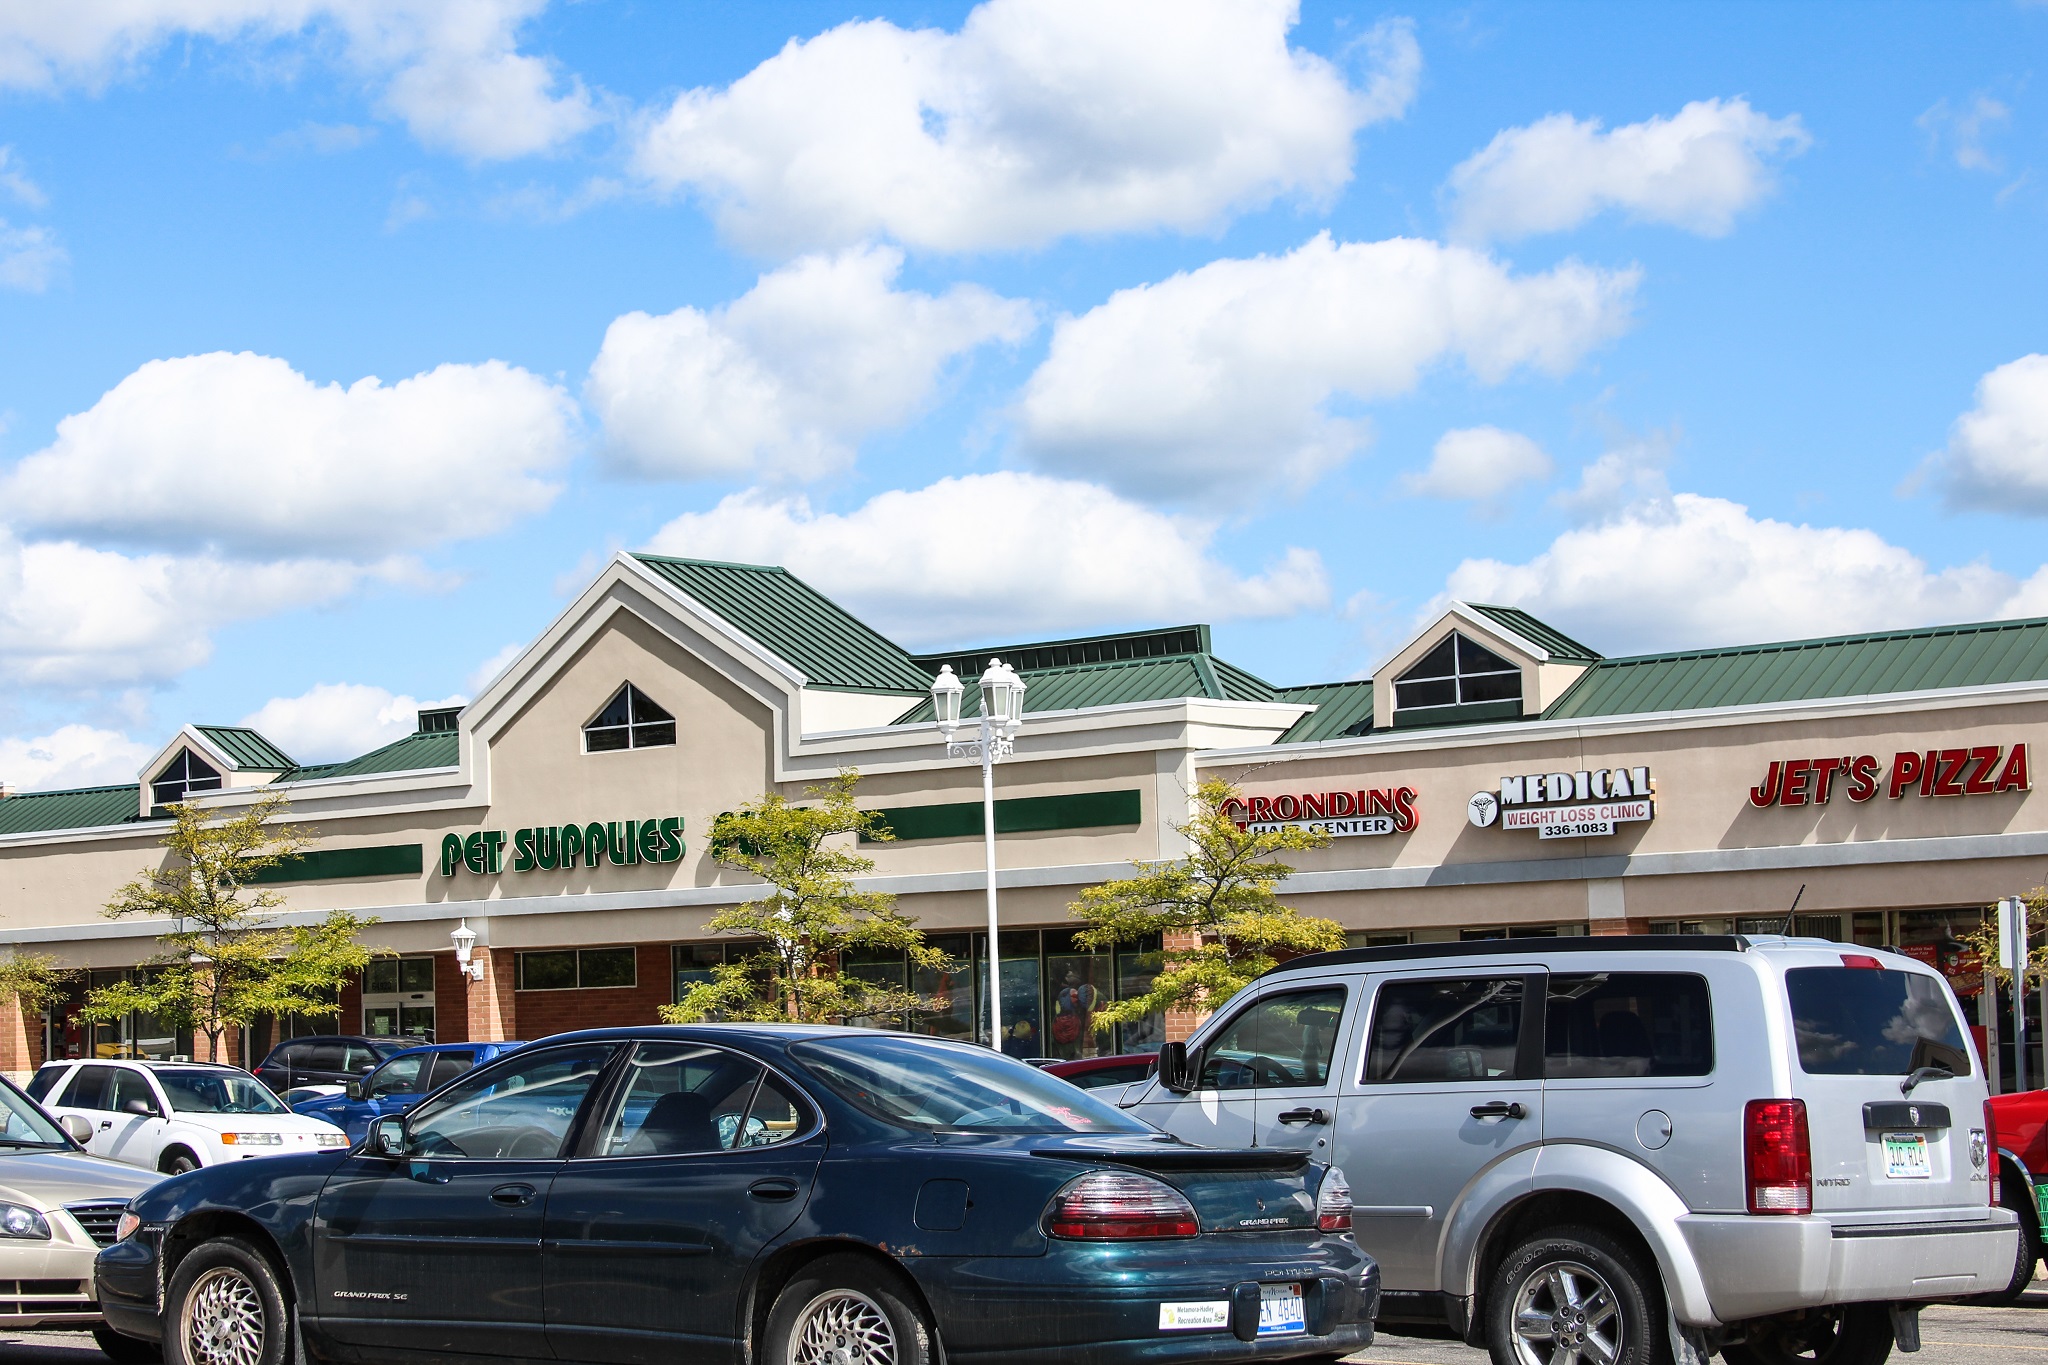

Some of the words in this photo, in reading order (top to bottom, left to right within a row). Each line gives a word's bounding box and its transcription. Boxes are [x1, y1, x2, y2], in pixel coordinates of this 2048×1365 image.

[1749, 754, 1882, 808] JET'S
[1887, 742, 2032, 800] PIZZA
[1500, 766, 1652, 805] MEDICAL
[1507, 810, 1556, 826] WEIGHT
[1560, 807, 1596, 823] LOSS
[1600, 803, 1646, 820] CLINIC
[1309, 819, 1388, 835] CENTER
[1545, 822, 1608, 836] 336-1083
[440, 830, 507, 877] PET
[513, 816, 687, 873] SUPPLIES
[1889, 1146, 1905, 1166] 3JC
[1816, 1178, 1851, 1187] NITRO
[1239, 1218, 1270, 1226] GRAND
[1270, 1217, 1289, 1225] PRIX
[1505, 1243, 1599, 1285] GOODYEAR
[333, 1290, 367, 1298] GRAND
[1176, 1305, 1214, 1314] Metamora-Hadley
[1278, 1296, 1302, 1321] 4840
[1177, 1316, 1202, 1325] Recreation
[1202, 1316, 1213, 1324] Area
